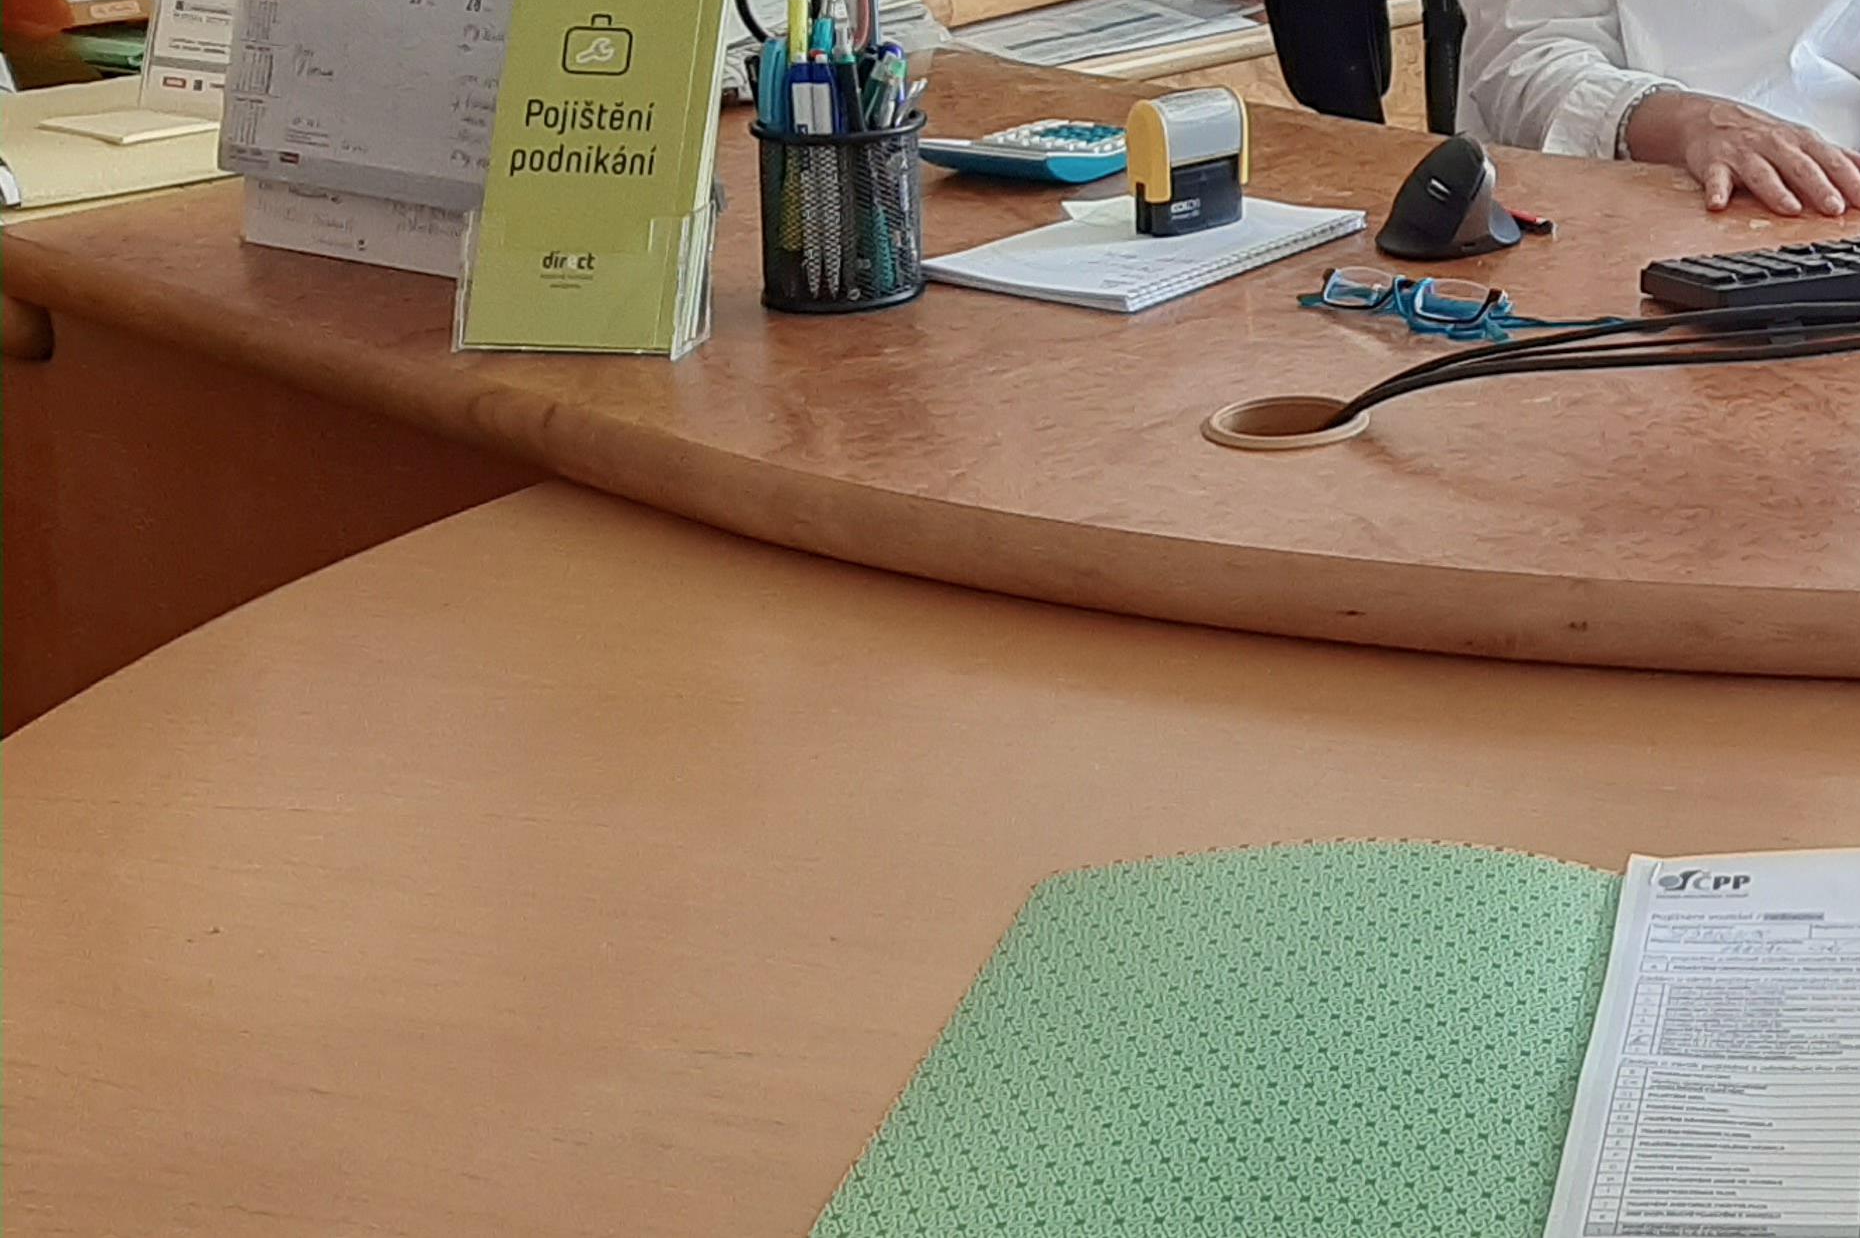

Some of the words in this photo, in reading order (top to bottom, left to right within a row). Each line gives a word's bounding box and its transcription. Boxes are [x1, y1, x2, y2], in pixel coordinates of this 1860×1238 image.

[525, 98, 655, 135] Pojištění
[509, 143, 657, 178] podnikání
[1693, 870, 1751, 890] ČPP
